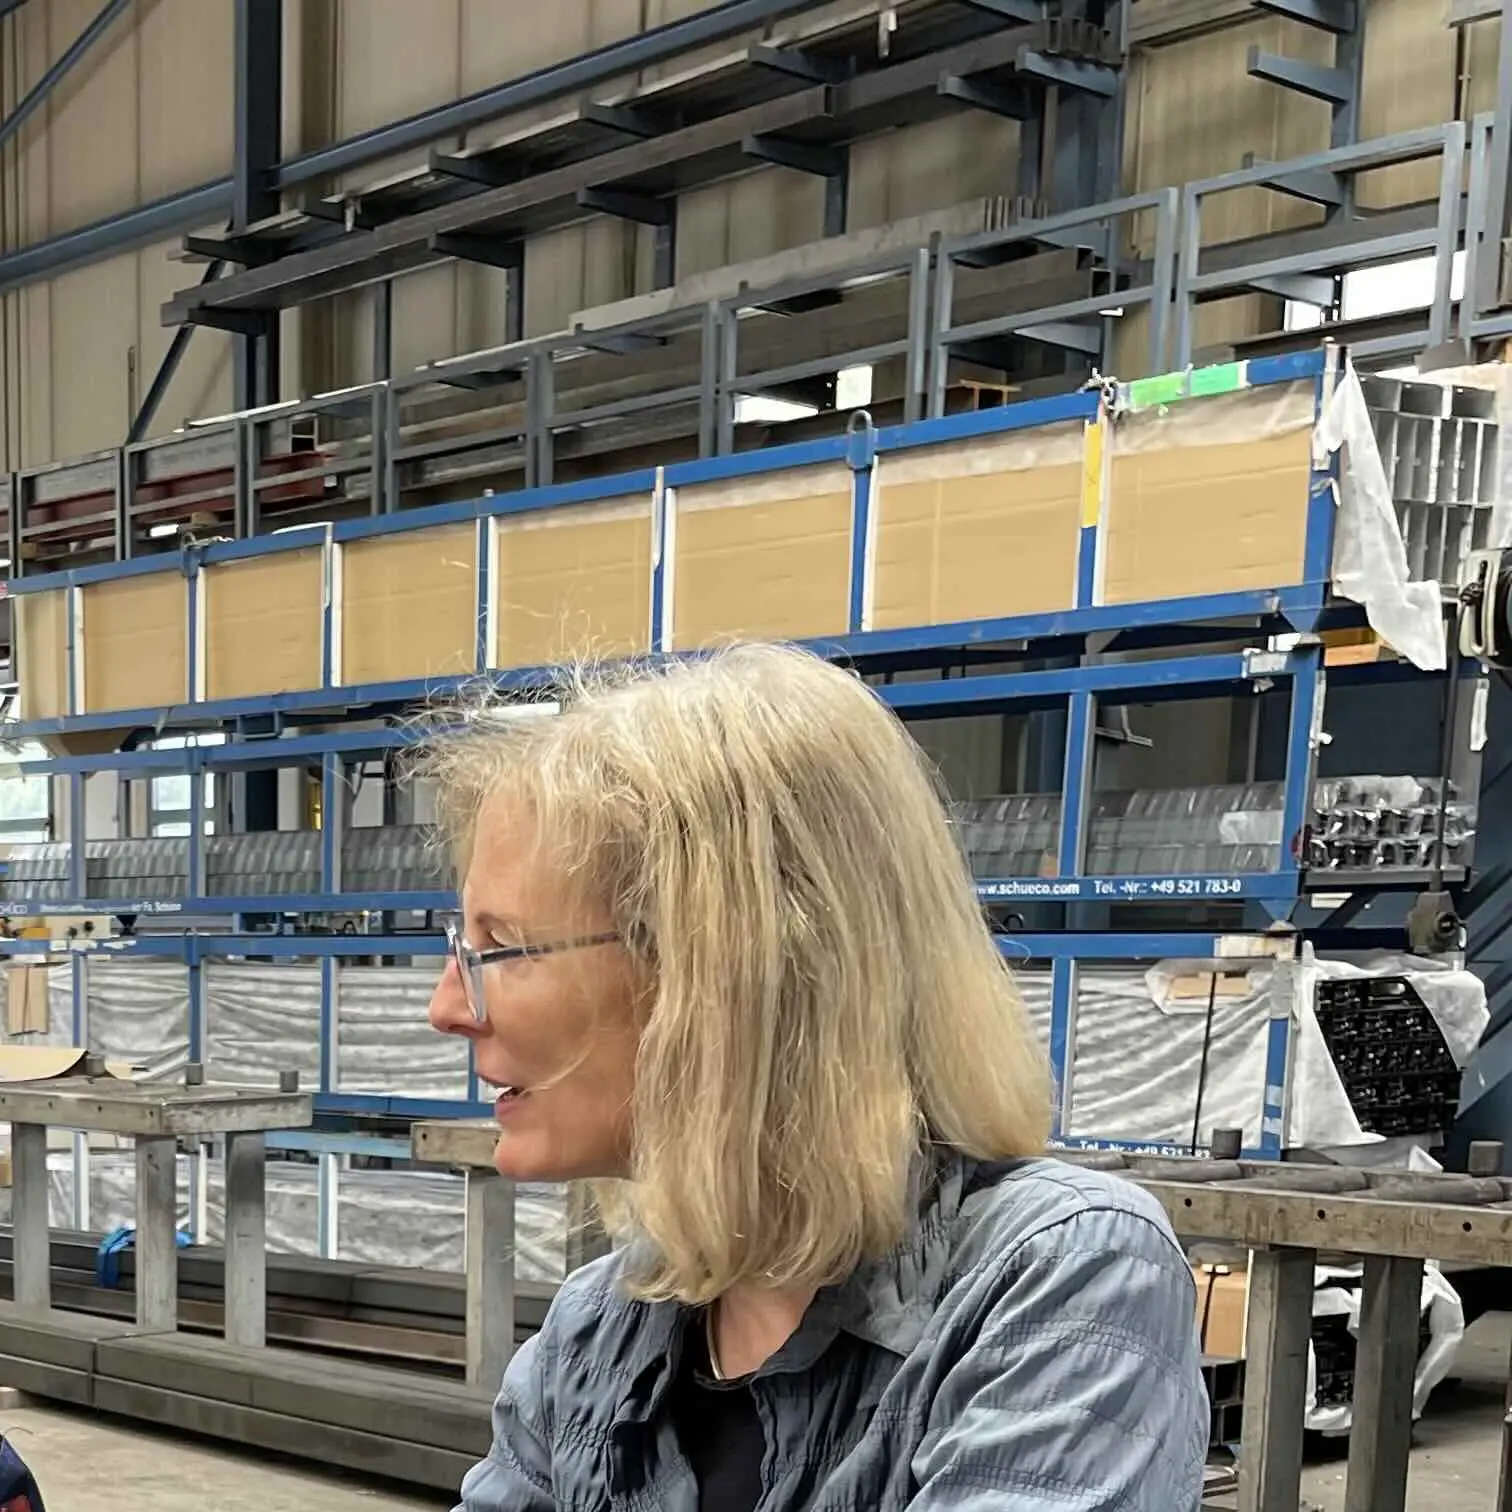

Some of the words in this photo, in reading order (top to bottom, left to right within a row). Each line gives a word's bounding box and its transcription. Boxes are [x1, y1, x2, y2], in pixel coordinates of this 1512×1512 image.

[977, 881, 1080, 895] ww.schueco.com
[1151, 880, 1175, 894] +49
[1177, 880, 1200, 893] 521
[1205, 880, 1241, 893] 783-0
